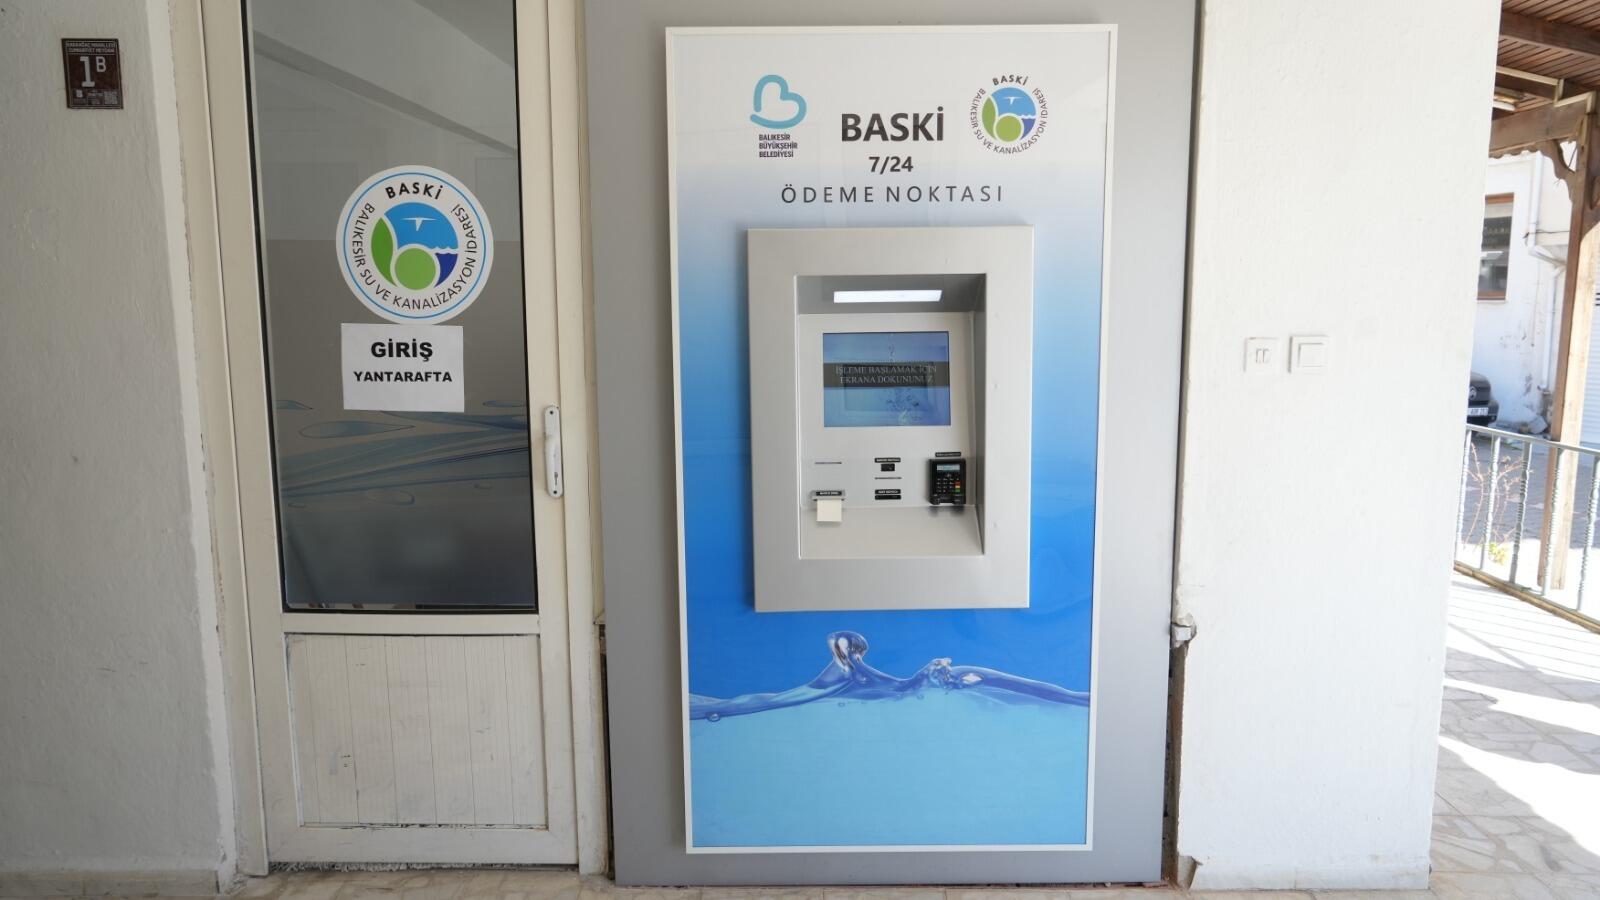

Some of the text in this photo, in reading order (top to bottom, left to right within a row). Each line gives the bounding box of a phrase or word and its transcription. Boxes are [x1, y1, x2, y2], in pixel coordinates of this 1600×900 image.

[992, 75, 1029, 85] BASKİ
[970, 88, 986, 128] BALIKESİR
[841, 106, 944, 142] BASKİ
[758, 133, 791, 141] BALIKESİR
[974, 129, 984, 140] SU
[993, 120, 1047, 154] KANALİZASYON
[758, 141, 798, 150] BÜYÜKŞEHİR
[983, 139, 993, 150] VE
[759, 150, 794, 158] BELEDİYESİ
[868, 156, 914, 175] 7/24
[385, 182, 444, 200] BASKİ
[781, 184, 1003, 203] ÖDEME NOKTASI
[352, 203, 478, 310] BALIKESİR SU VE KANALİZASYON İDARESİ
[371, 338, 433, 362] GİRİŞ
[353, 371, 452, 382] YANTARAFTA
